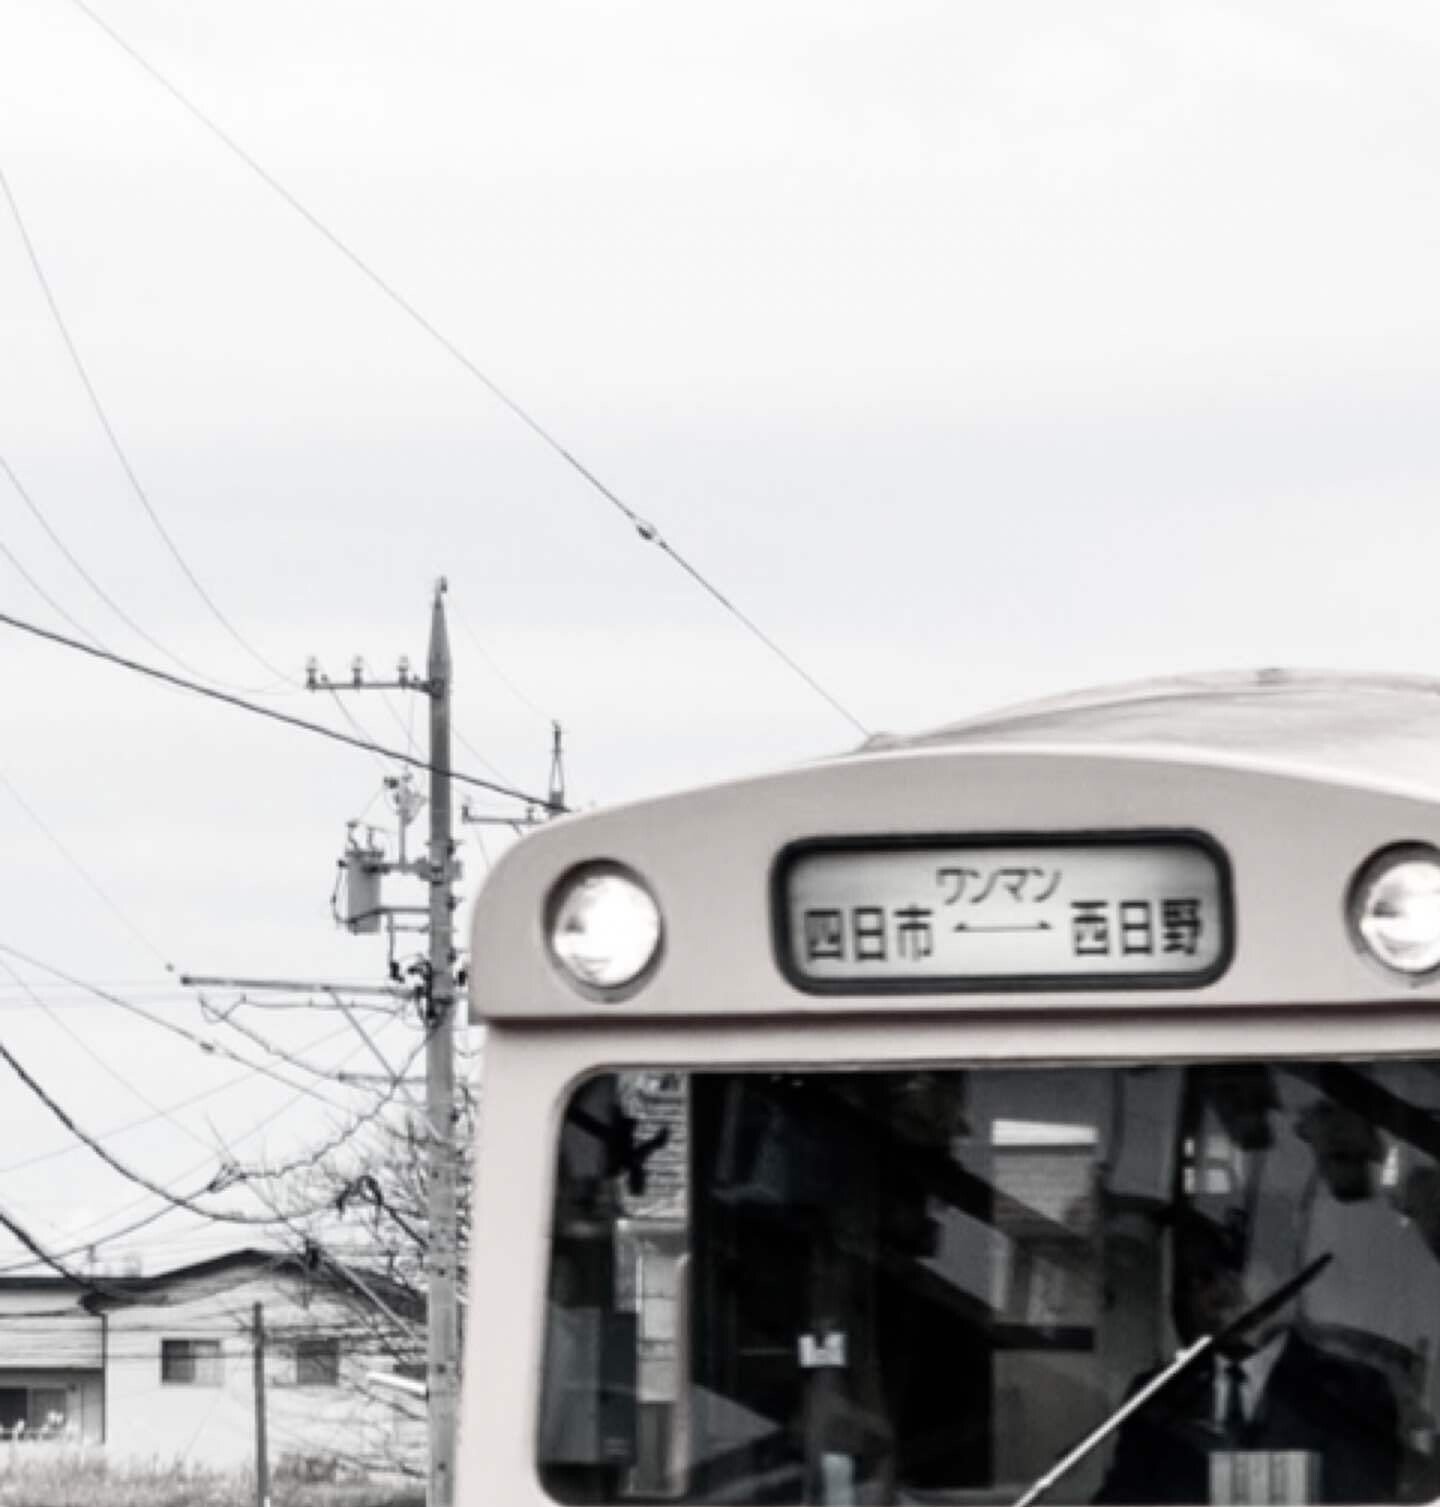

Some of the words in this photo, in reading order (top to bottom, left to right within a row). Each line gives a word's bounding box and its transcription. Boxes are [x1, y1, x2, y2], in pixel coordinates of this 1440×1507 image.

[935, 867, 1063, 905] ワンマン
[804, 905, 934, 963] 四日市
[1070, 899, 1203, 957] 西日野
